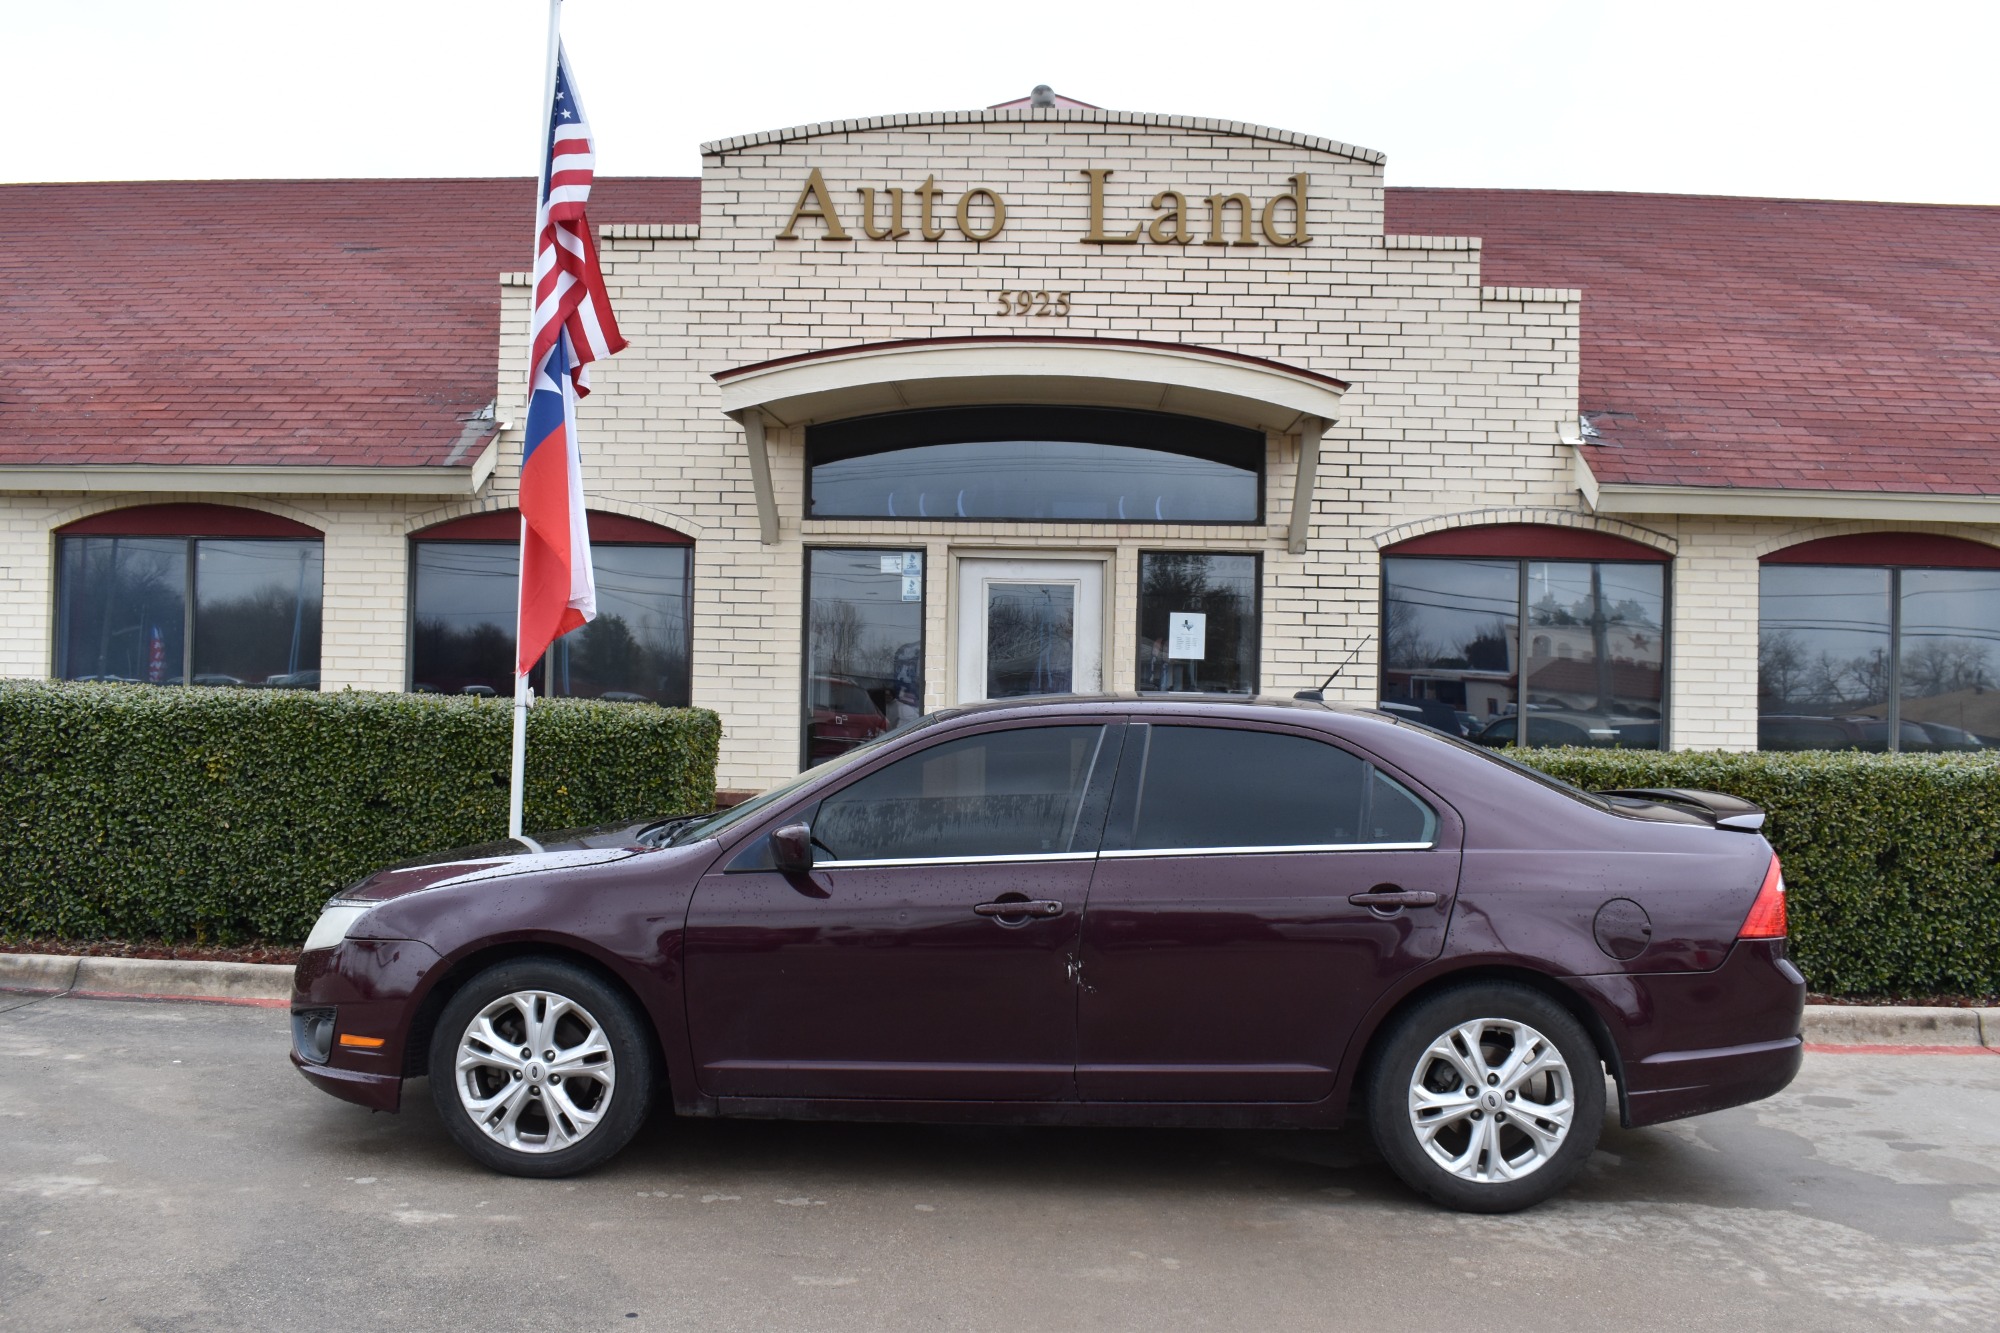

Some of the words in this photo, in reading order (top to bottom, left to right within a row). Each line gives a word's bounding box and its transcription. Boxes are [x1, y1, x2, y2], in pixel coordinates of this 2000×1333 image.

[775, 167, 1006, 242] Auto
[1079, 168, 1313, 247] Land
[996, 289, 1071, 318] 5925
